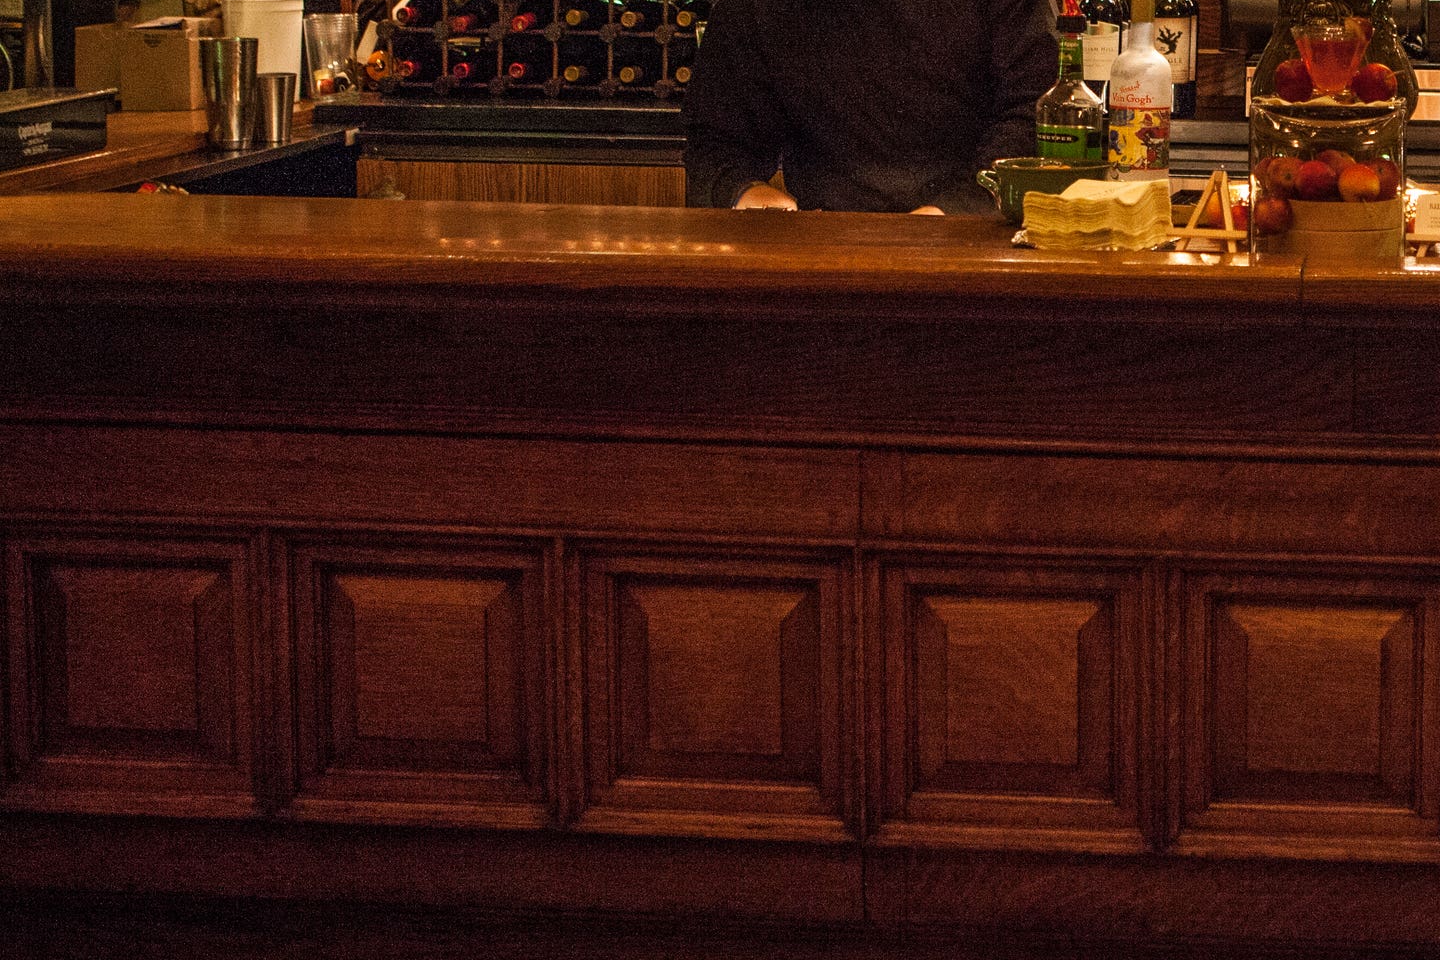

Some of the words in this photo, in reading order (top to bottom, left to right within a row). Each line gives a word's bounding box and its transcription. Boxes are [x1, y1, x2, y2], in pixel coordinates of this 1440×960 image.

[1112, 93, 1125, 102] Van
[1126, 93, 1152, 106] Gogh
[1037, 134, 1072, 142] EKUYPER
